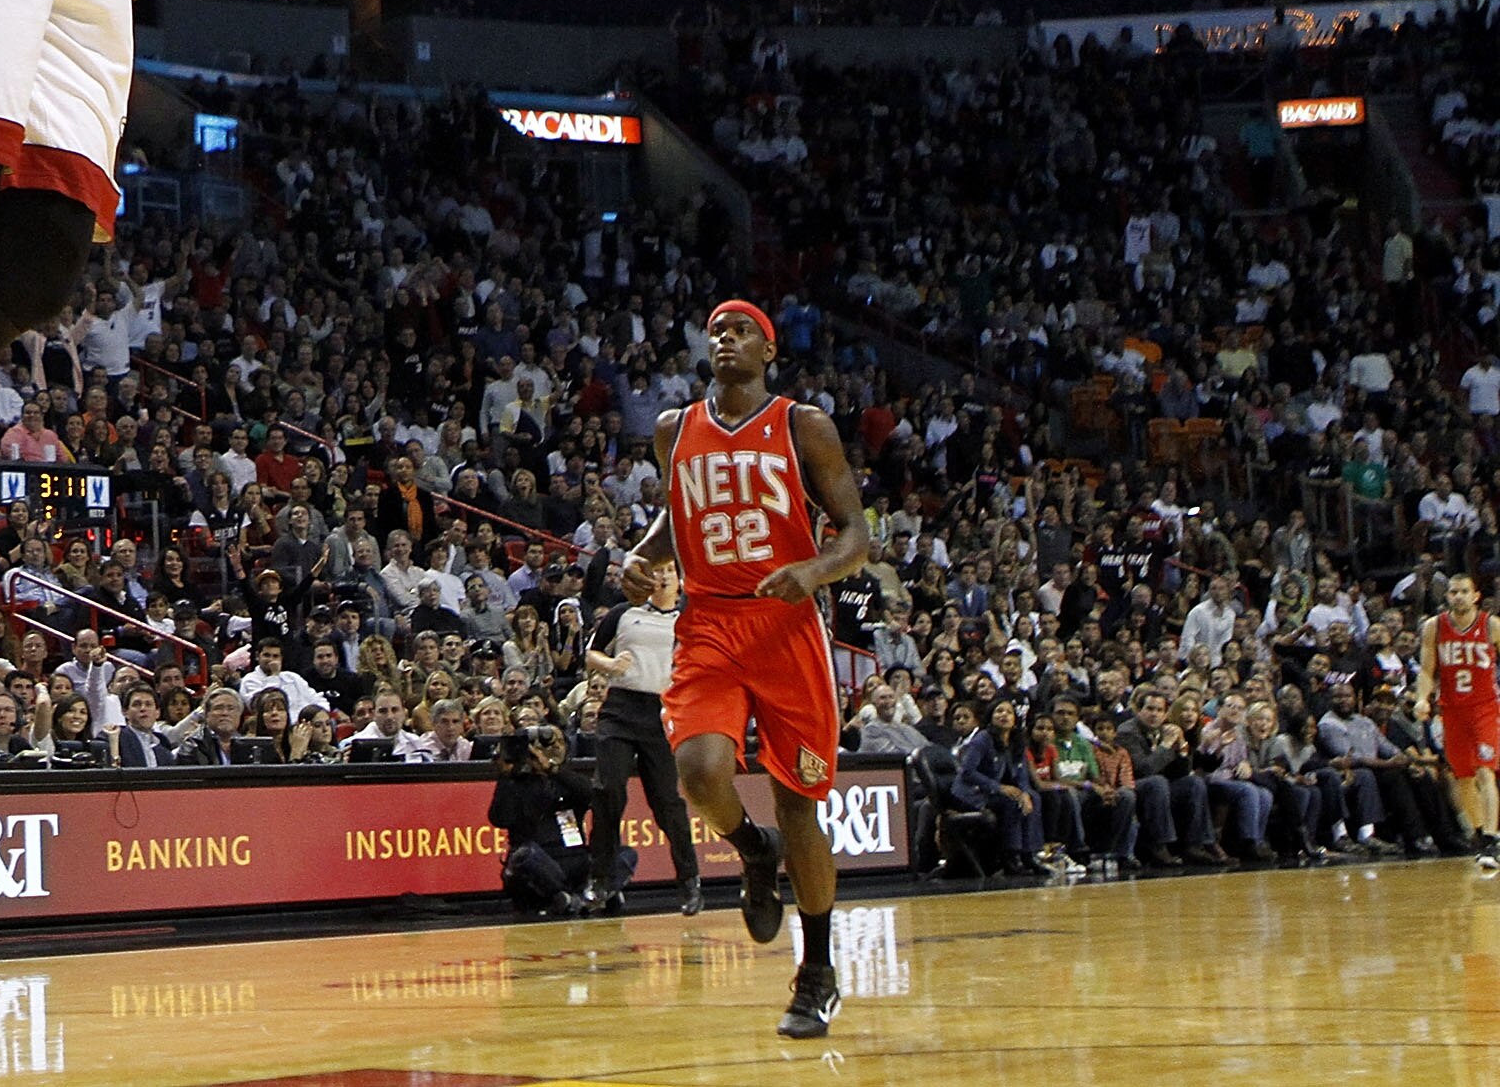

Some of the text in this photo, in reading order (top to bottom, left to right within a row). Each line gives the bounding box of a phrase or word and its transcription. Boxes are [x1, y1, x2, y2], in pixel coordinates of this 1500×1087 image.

[1280, 101, 1357, 124] BACARDI
[40, 473, 86, 498] 3:11
[677, 450, 791, 520] NETS
[701, 508, 774, 565] 22
[1438, 641, 1491, 670] NETS
[1455, 669, 1473, 693] 2
[817, 785, 899, 856] B&T
[106, 835, 252, 872] BANKING
[345, 825, 507, 861] INSURANCE
